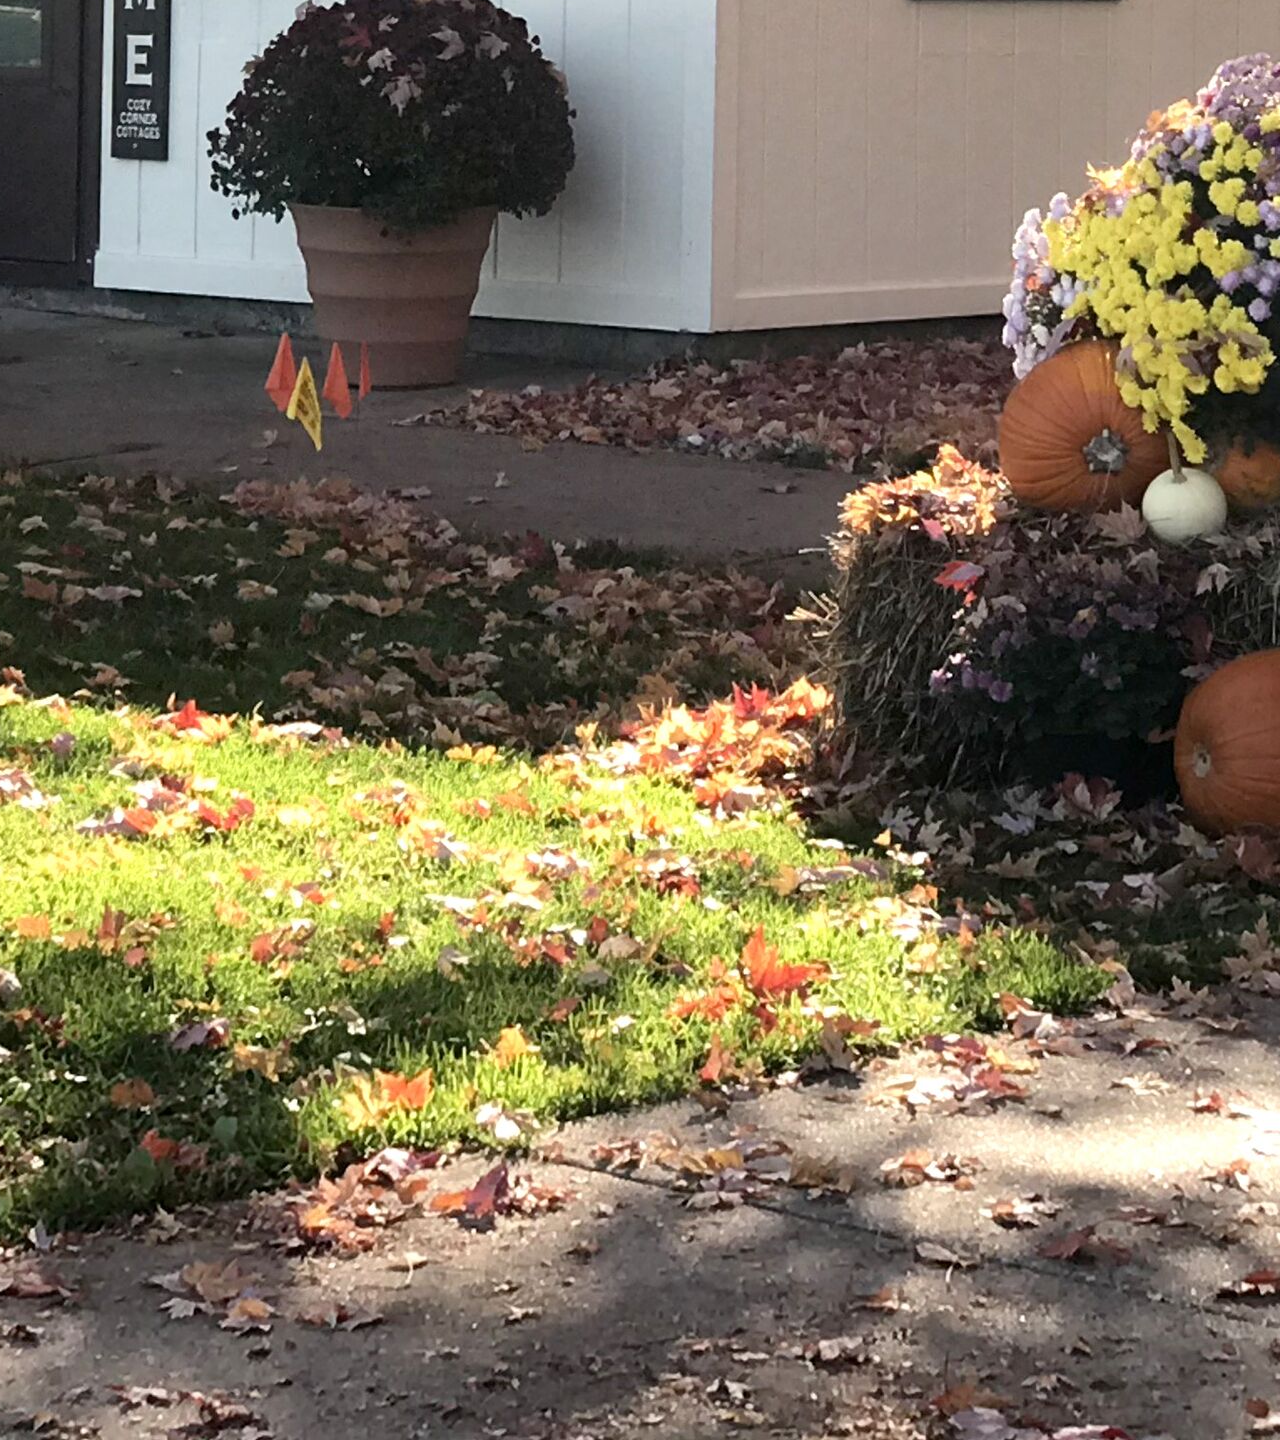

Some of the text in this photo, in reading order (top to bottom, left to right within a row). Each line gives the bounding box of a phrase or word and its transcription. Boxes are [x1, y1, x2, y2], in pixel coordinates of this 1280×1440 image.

[126, 98, 152, 112] COZY
[119, 111, 158, 126] CORNER
[116, 125, 161, 140] COTTAGES
